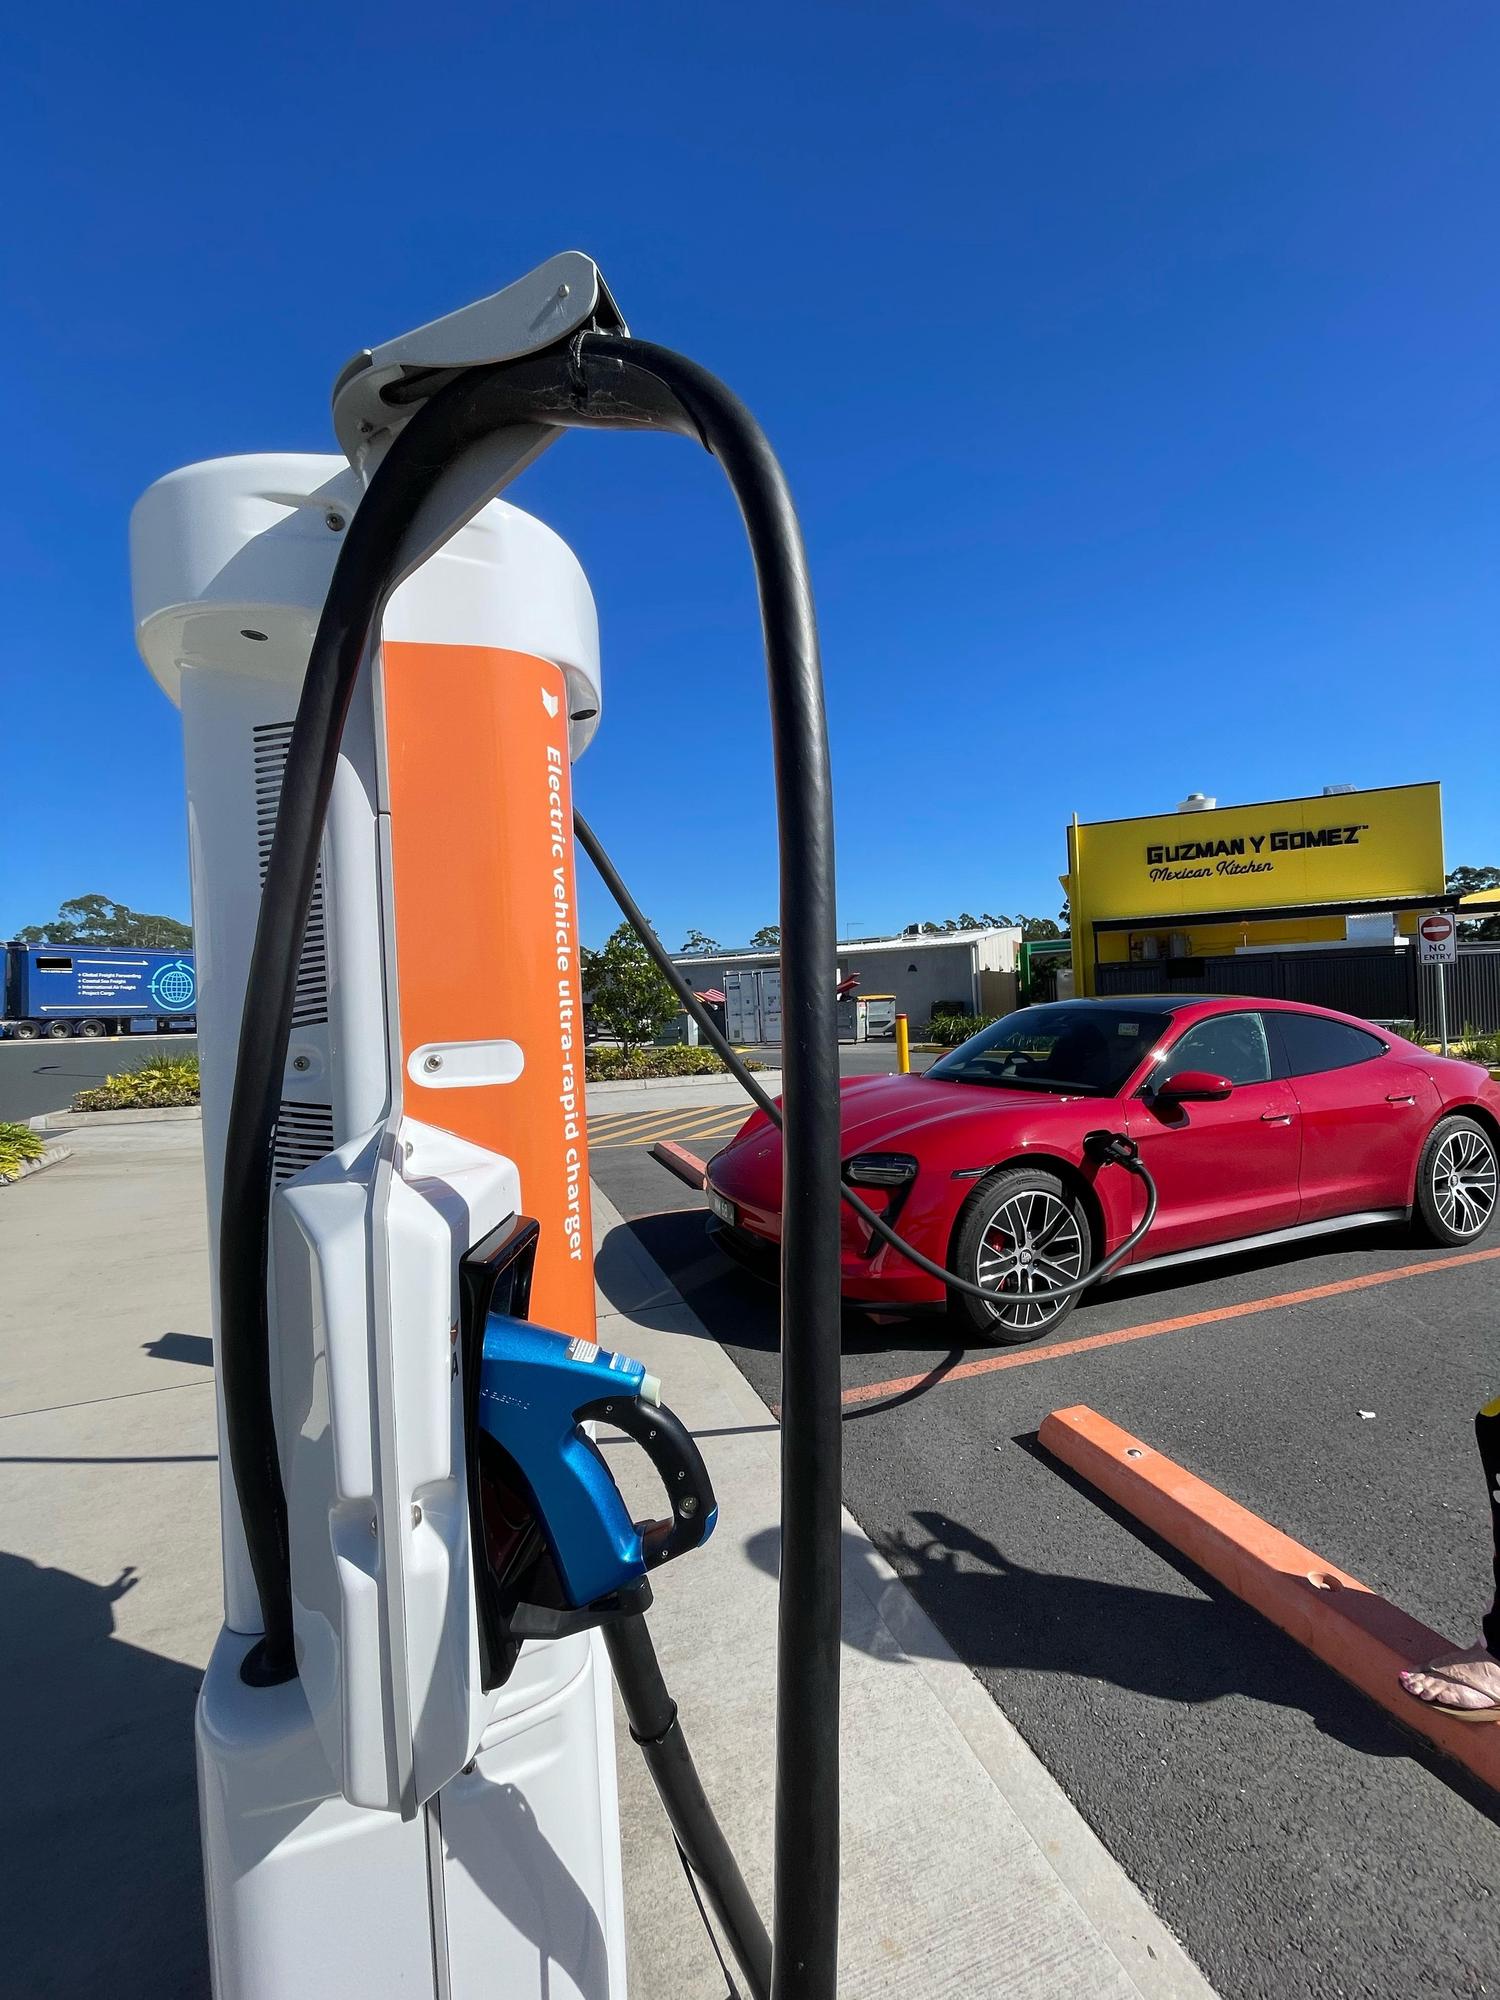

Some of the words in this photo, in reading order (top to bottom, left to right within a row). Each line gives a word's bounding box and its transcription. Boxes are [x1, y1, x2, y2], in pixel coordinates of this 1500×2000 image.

[546, 746, 567, 859] Electric
[1146, 837, 1245, 866] GUZMAN
[1249, 835, 1266, 854] Y
[1149, 867, 1213, 883] Mexican
[1216, 859, 1274, 877] Kitchen
[552, 866, 572, 972] vehicle
[1429, 943, 1446, 952] NO
[1424, 953, 1451, 961] ENTRY
[557, 980, 580, 1141] ultra-rapid
[563, 1147, 582, 1261] charger
